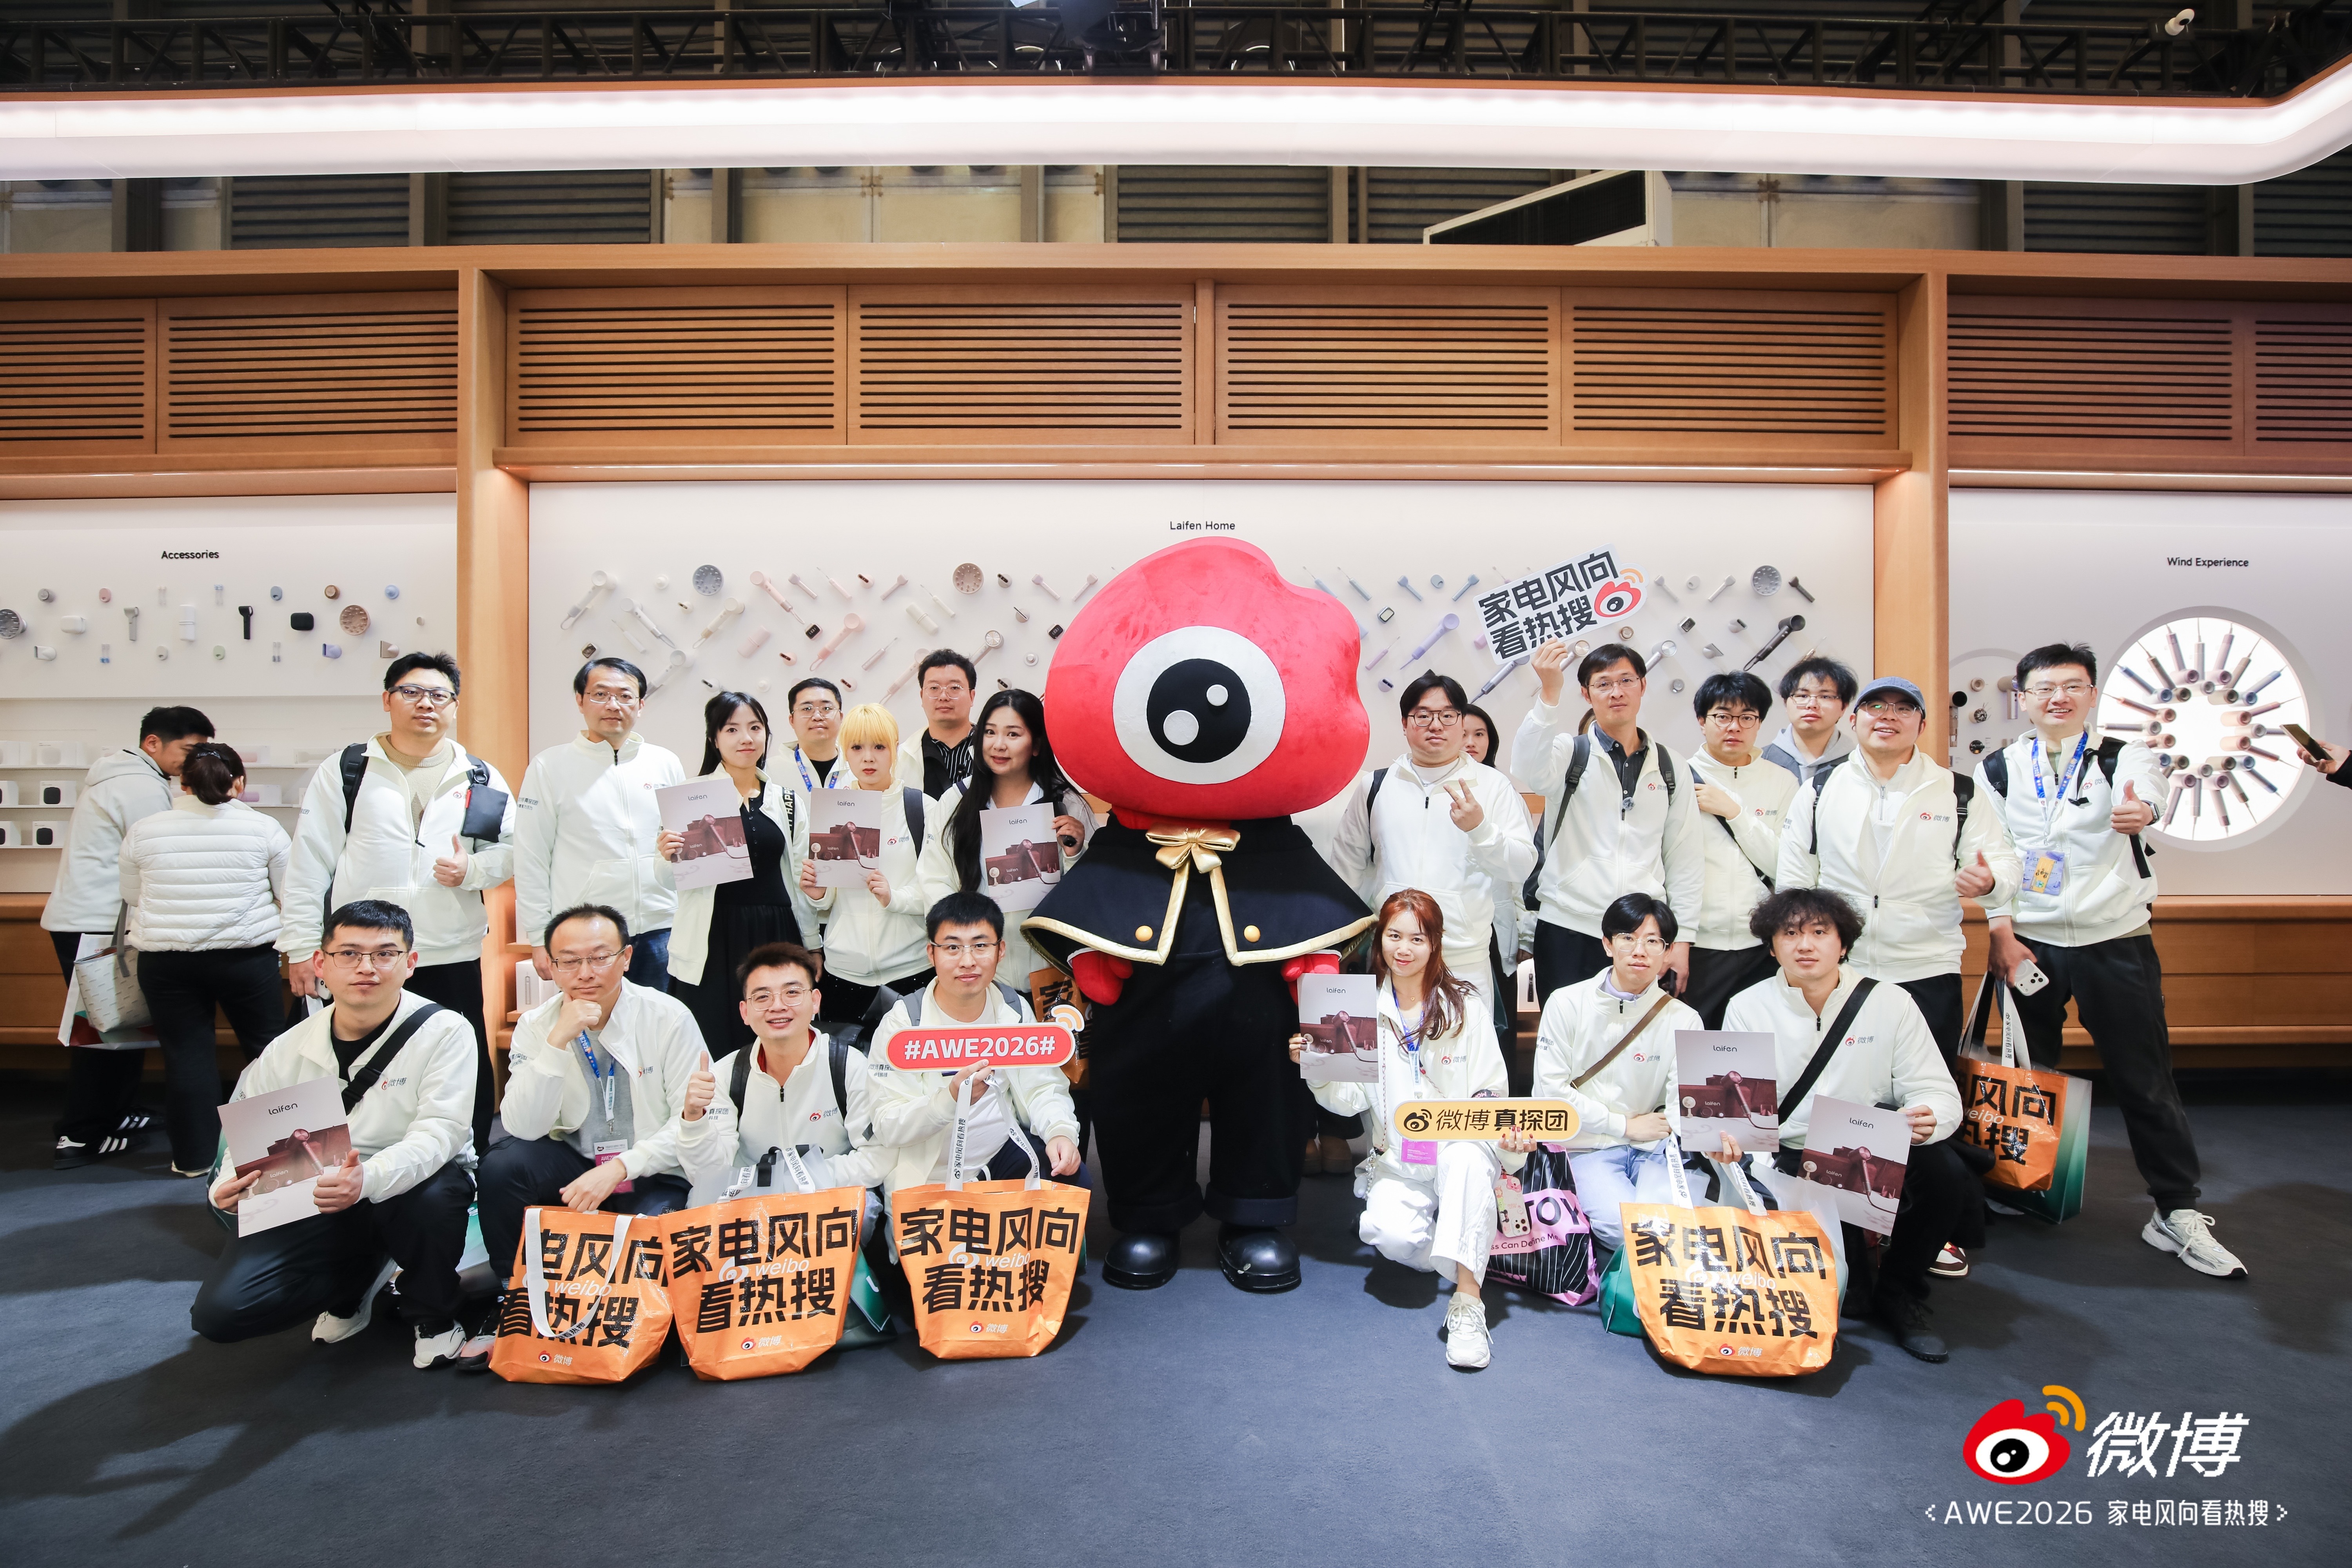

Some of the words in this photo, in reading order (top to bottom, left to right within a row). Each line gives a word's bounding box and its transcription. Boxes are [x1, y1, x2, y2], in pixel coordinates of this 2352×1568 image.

[1170, 521, 1201, 530] Laifen
[1206, 521, 1235, 530] Home
[161, 550, 220, 559] Accessories
[2167, 557, 2192, 566] Wind
[2196, 557, 2249, 568] Experience
[1478, 551, 1619, 628] 家电风向
[1490, 595, 1597, 659] 看热搜
[1933, 814, 1950, 823] 微博
[1857, 1036, 1875, 1044] 微博
[904, 1036, 1055, 1060] #AWE2026#
[269, 1103, 298, 1115] laifen
[824, 1107, 838, 1118] 微博
[1850, 1118, 1874, 1129] laifen
[954, 1118, 966, 1169] 家电风向看热搜
[270, 1169, 289, 1178] laifen
[900, 1207, 1080, 1257] 家电风向
[670, 1207, 858, 1279] 家电风向
[1522, 1236, 1546, 1247] Define
[1631, 1219, 1826, 1280] 家电风向
[755, 1258, 809, 1277] weibo
[985, 1252, 1030, 1269] weibo
[554, 1280, 612, 1296] weibo
[922, 1259, 1050, 1314] 看热搜
[1726, 1272, 1777, 1290] weibo
[696, 1267, 837, 1333] 看热搜
[1660, 1278, 1818, 1339] 看热搜
[985, 1323, 1009, 1334] 微博
[758, 1335, 782, 1348] 微博
[1737, 1346, 1763, 1358] 微博
[554, 1354, 573, 1366] 微博
